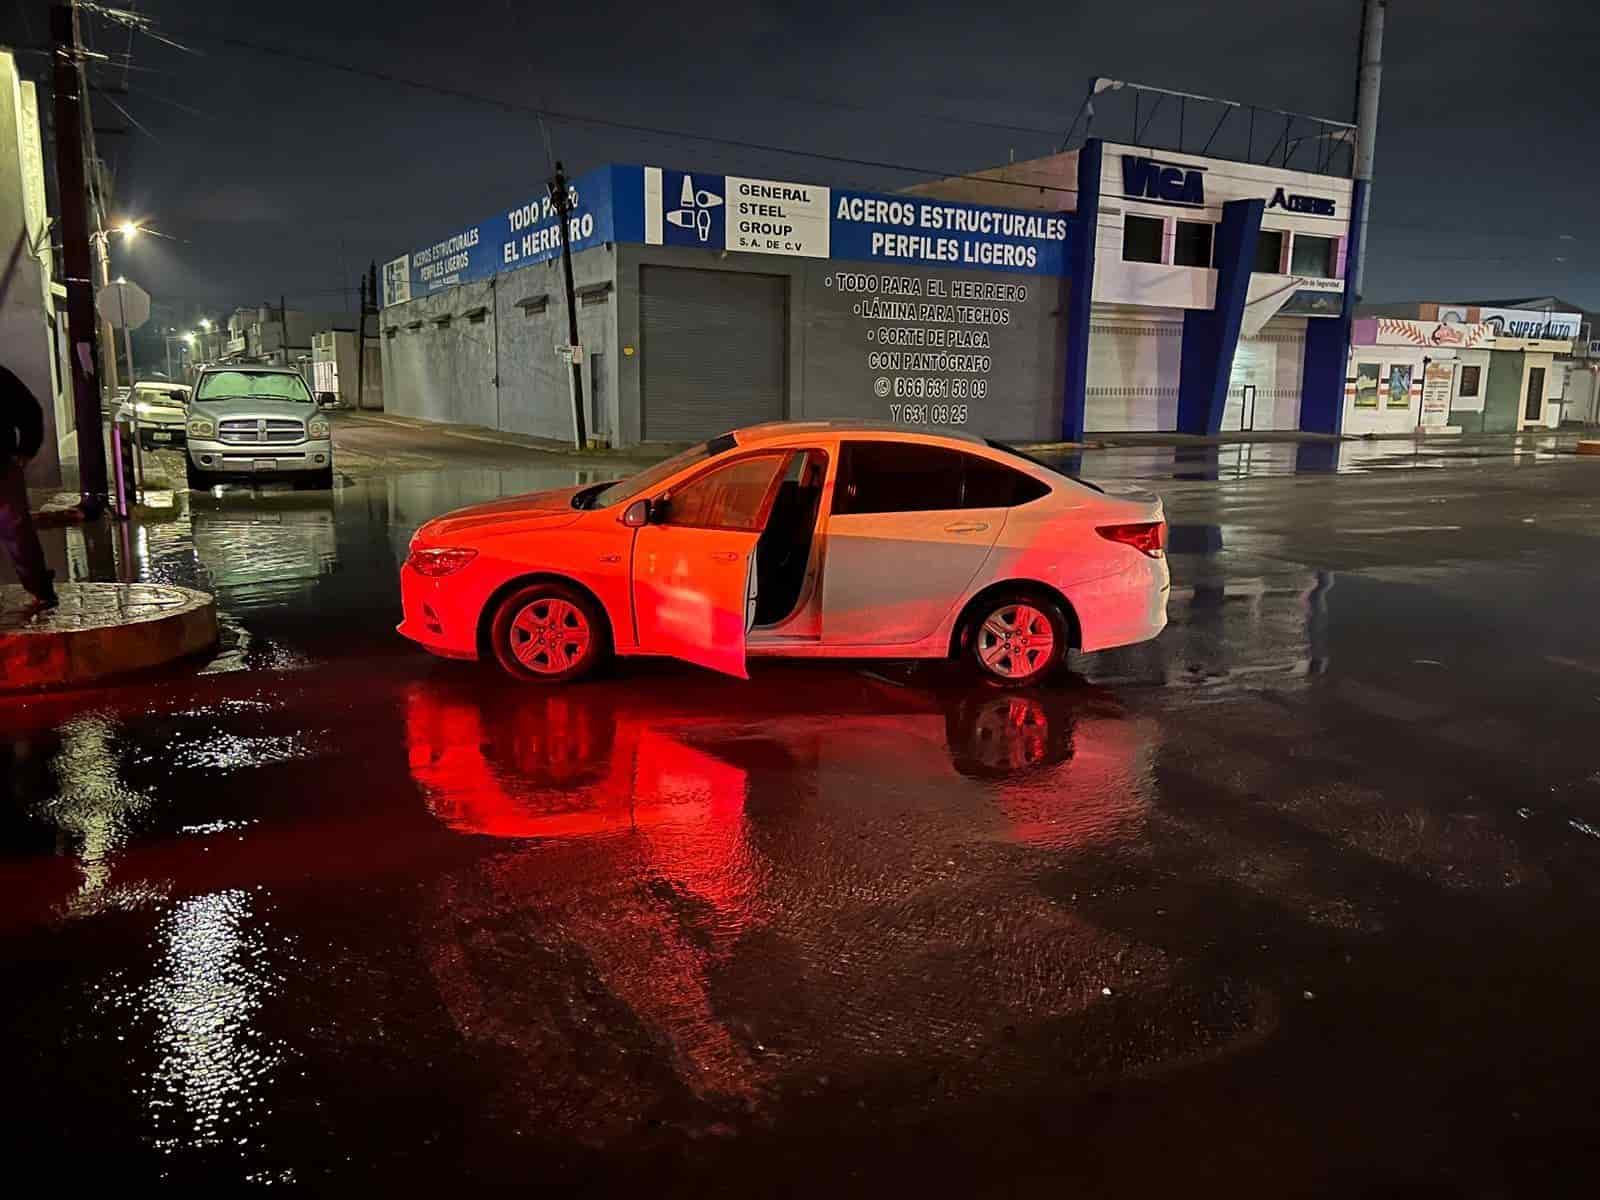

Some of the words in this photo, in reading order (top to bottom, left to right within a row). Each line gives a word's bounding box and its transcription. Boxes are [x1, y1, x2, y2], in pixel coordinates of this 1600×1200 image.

[739, 184, 811, 203] GENERAL
[508, 201, 539, 233] TODO
[739, 202, 787, 218] STEEL
[836, 196, 915, 226] ACEROS
[920, 205, 1068, 240] ESTRUCTURALES
[503, 240, 520, 264] EL
[522, 213, 594, 257] HERRRO
[739, 221, 793, 237] GROUP
[766, 240, 780, 249] DE
[872, 232, 959, 262] PERFILES
[963, 240, 1037, 268] LIGEROS
[836, 272, 878, 293] TODO
[880, 275, 922, 297] PARA
[926, 278, 947, 297] EL
[951, 280, 1027, 302] HERRERO
[862, 297, 917, 321] LÁMINA
[919, 303, 954, 323] PARA
[957, 306, 1010, 325] TECHOS
[878, 327, 924, 346] CORTE
[927, 329, 945, 347] DE
[947, 331, 990, 349] PLACA
[869, 351, 901, 370] CON
[903, 351, 992, 373] PANTÓGRAFO
[895, 377, 925, 398] 866
[926, 378, 949, 398] 631
[951, 378, 969, 399] 58
[970, 379, 988, 399] 09
[890, 404, 902, 423] Y
[903, 404, 928, 424] 631
[931, 404, 949, 424] 03
[950, 404, 968, 424] 25
